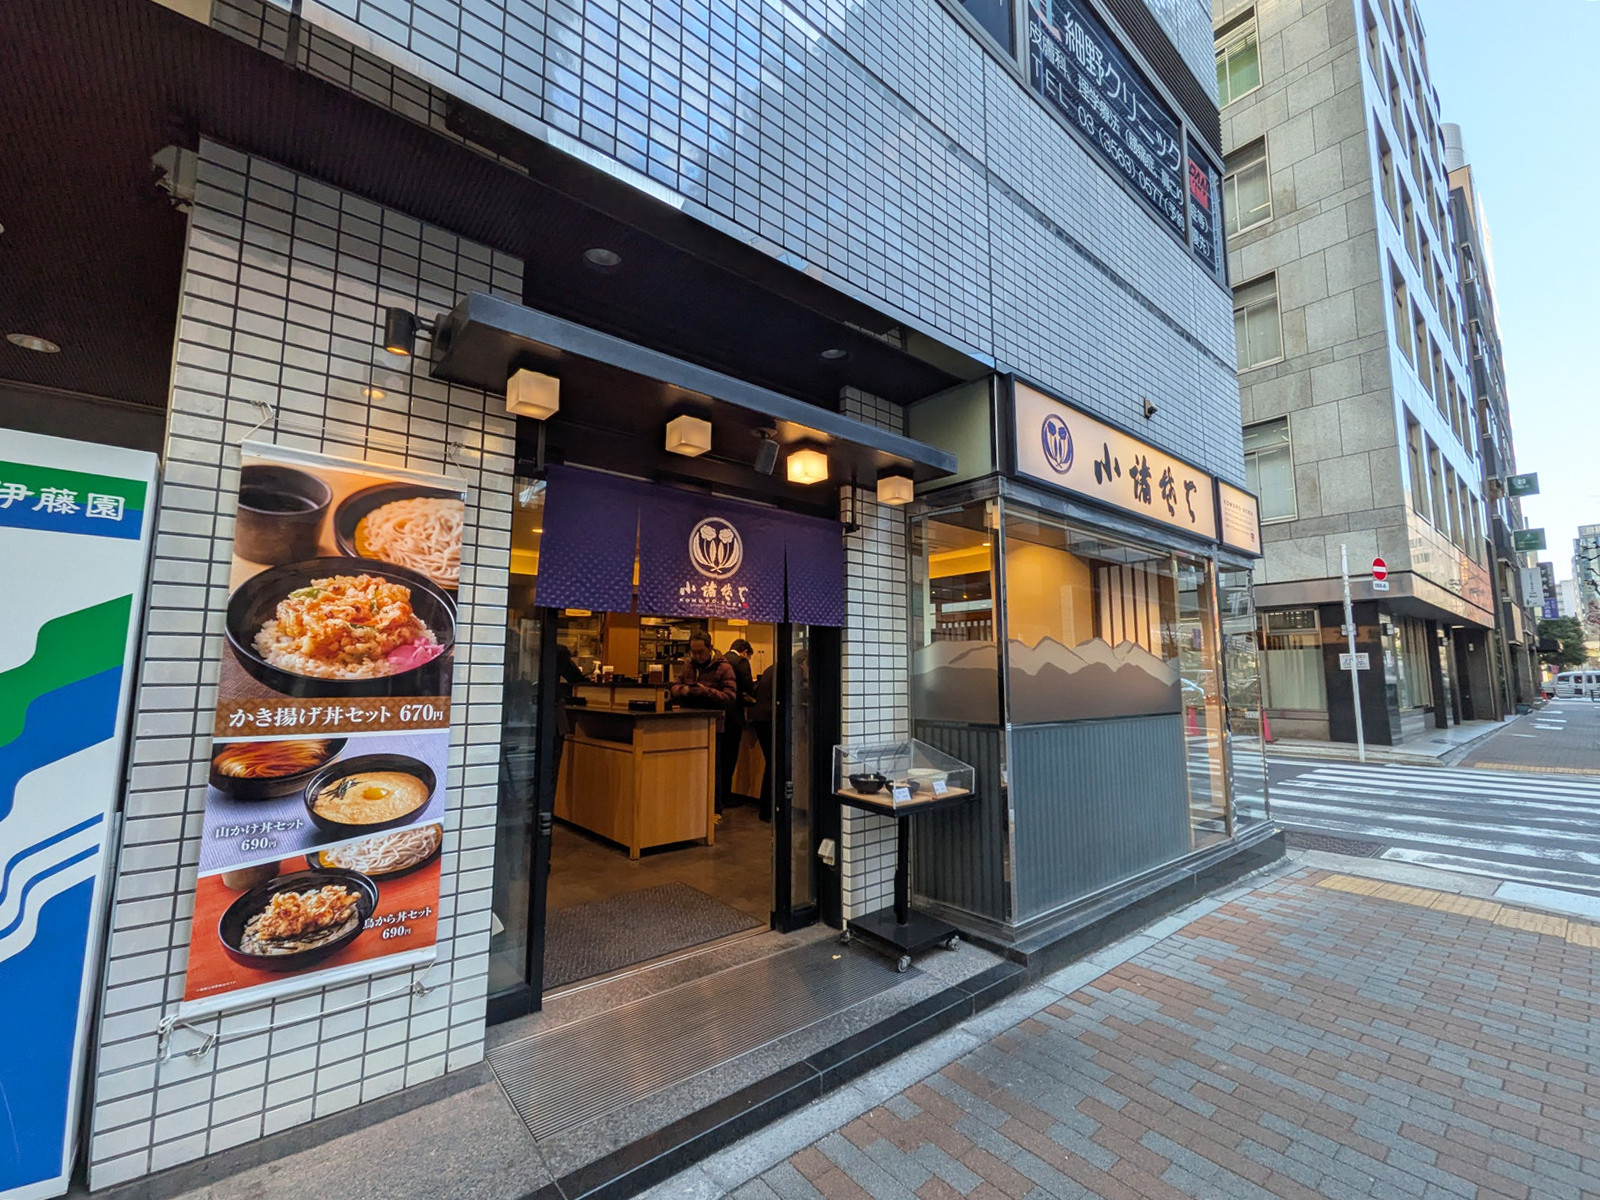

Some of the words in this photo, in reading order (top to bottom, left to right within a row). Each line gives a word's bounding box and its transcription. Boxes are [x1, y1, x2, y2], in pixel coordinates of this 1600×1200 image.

[1032, 52, 1069, 109] TEL
[1078, 105, 1095, 135] 03
[1065, 11, 1181, 172] 細野クリニック
[0, 481, 125, 521] 伊藤園
[229, 705, 392, 728] かき揚げ丼セット
[400, 704, 444, 722] 670円
[215, 819, 304, 839] 山かけ丼セット
[241, 837, 277, 851] 690円
[382, 925, 412, 940] 690円
